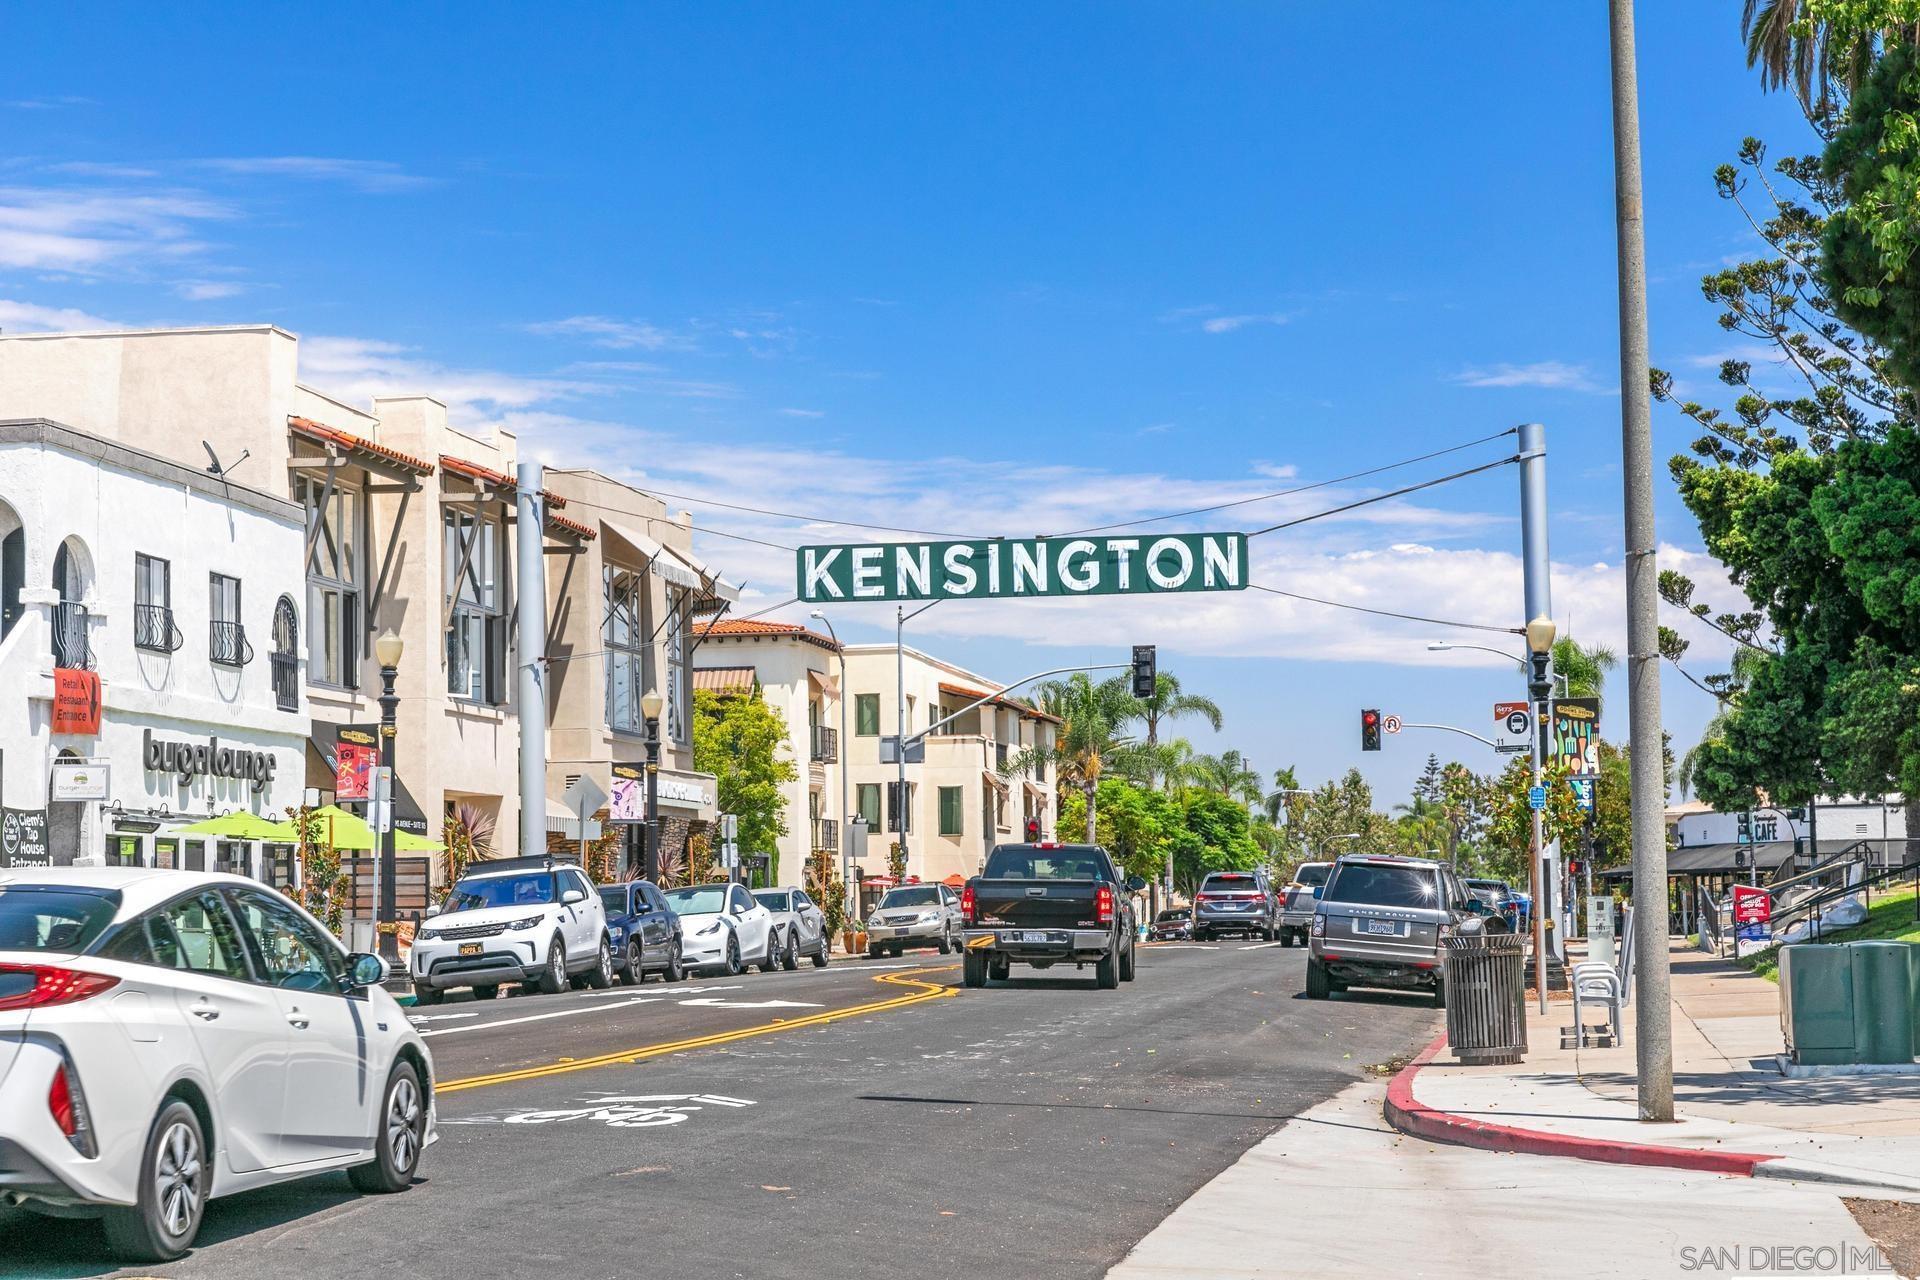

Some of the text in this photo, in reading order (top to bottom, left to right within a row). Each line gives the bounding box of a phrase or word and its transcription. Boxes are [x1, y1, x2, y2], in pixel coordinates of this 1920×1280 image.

[804, 536, 1239, 598] KENSINGTON
[62, 678, 79, 689] Retail
[1496, 738, 1504, 746] 11
[19, 813, 44, 827] Clem's
[25, 827, 39, 842] Tap
[20, 841, 45, 855] House
